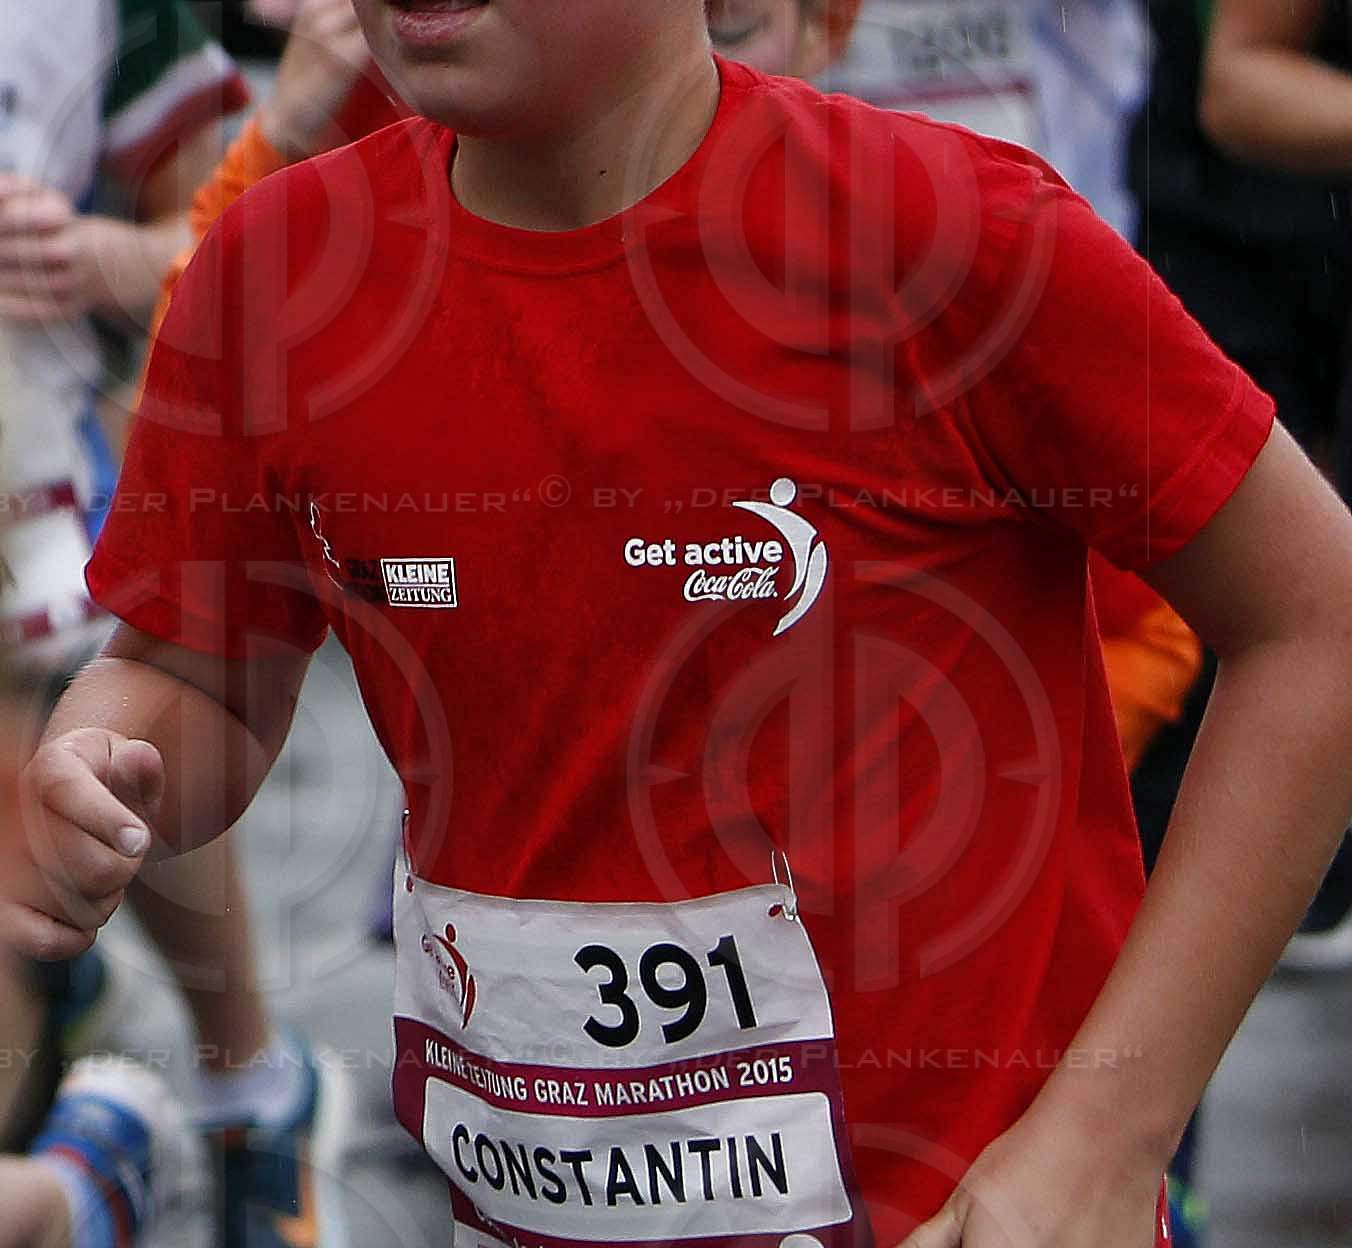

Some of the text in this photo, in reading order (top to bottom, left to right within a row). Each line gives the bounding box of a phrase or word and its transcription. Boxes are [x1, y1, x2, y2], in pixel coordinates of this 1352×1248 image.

[385, 563, 450, 583] KLEINE
[624, 535, 784, 567] Get active
[389, 586, 453, 603] ZEITUNG
[572, 934, 758, 1048] 391
[425, 1038, 794, 1107] KLEINE ZEITUNG GRAZ MARATHON 2015
[450, 1122, 790, 1208] CONSTANTIN
